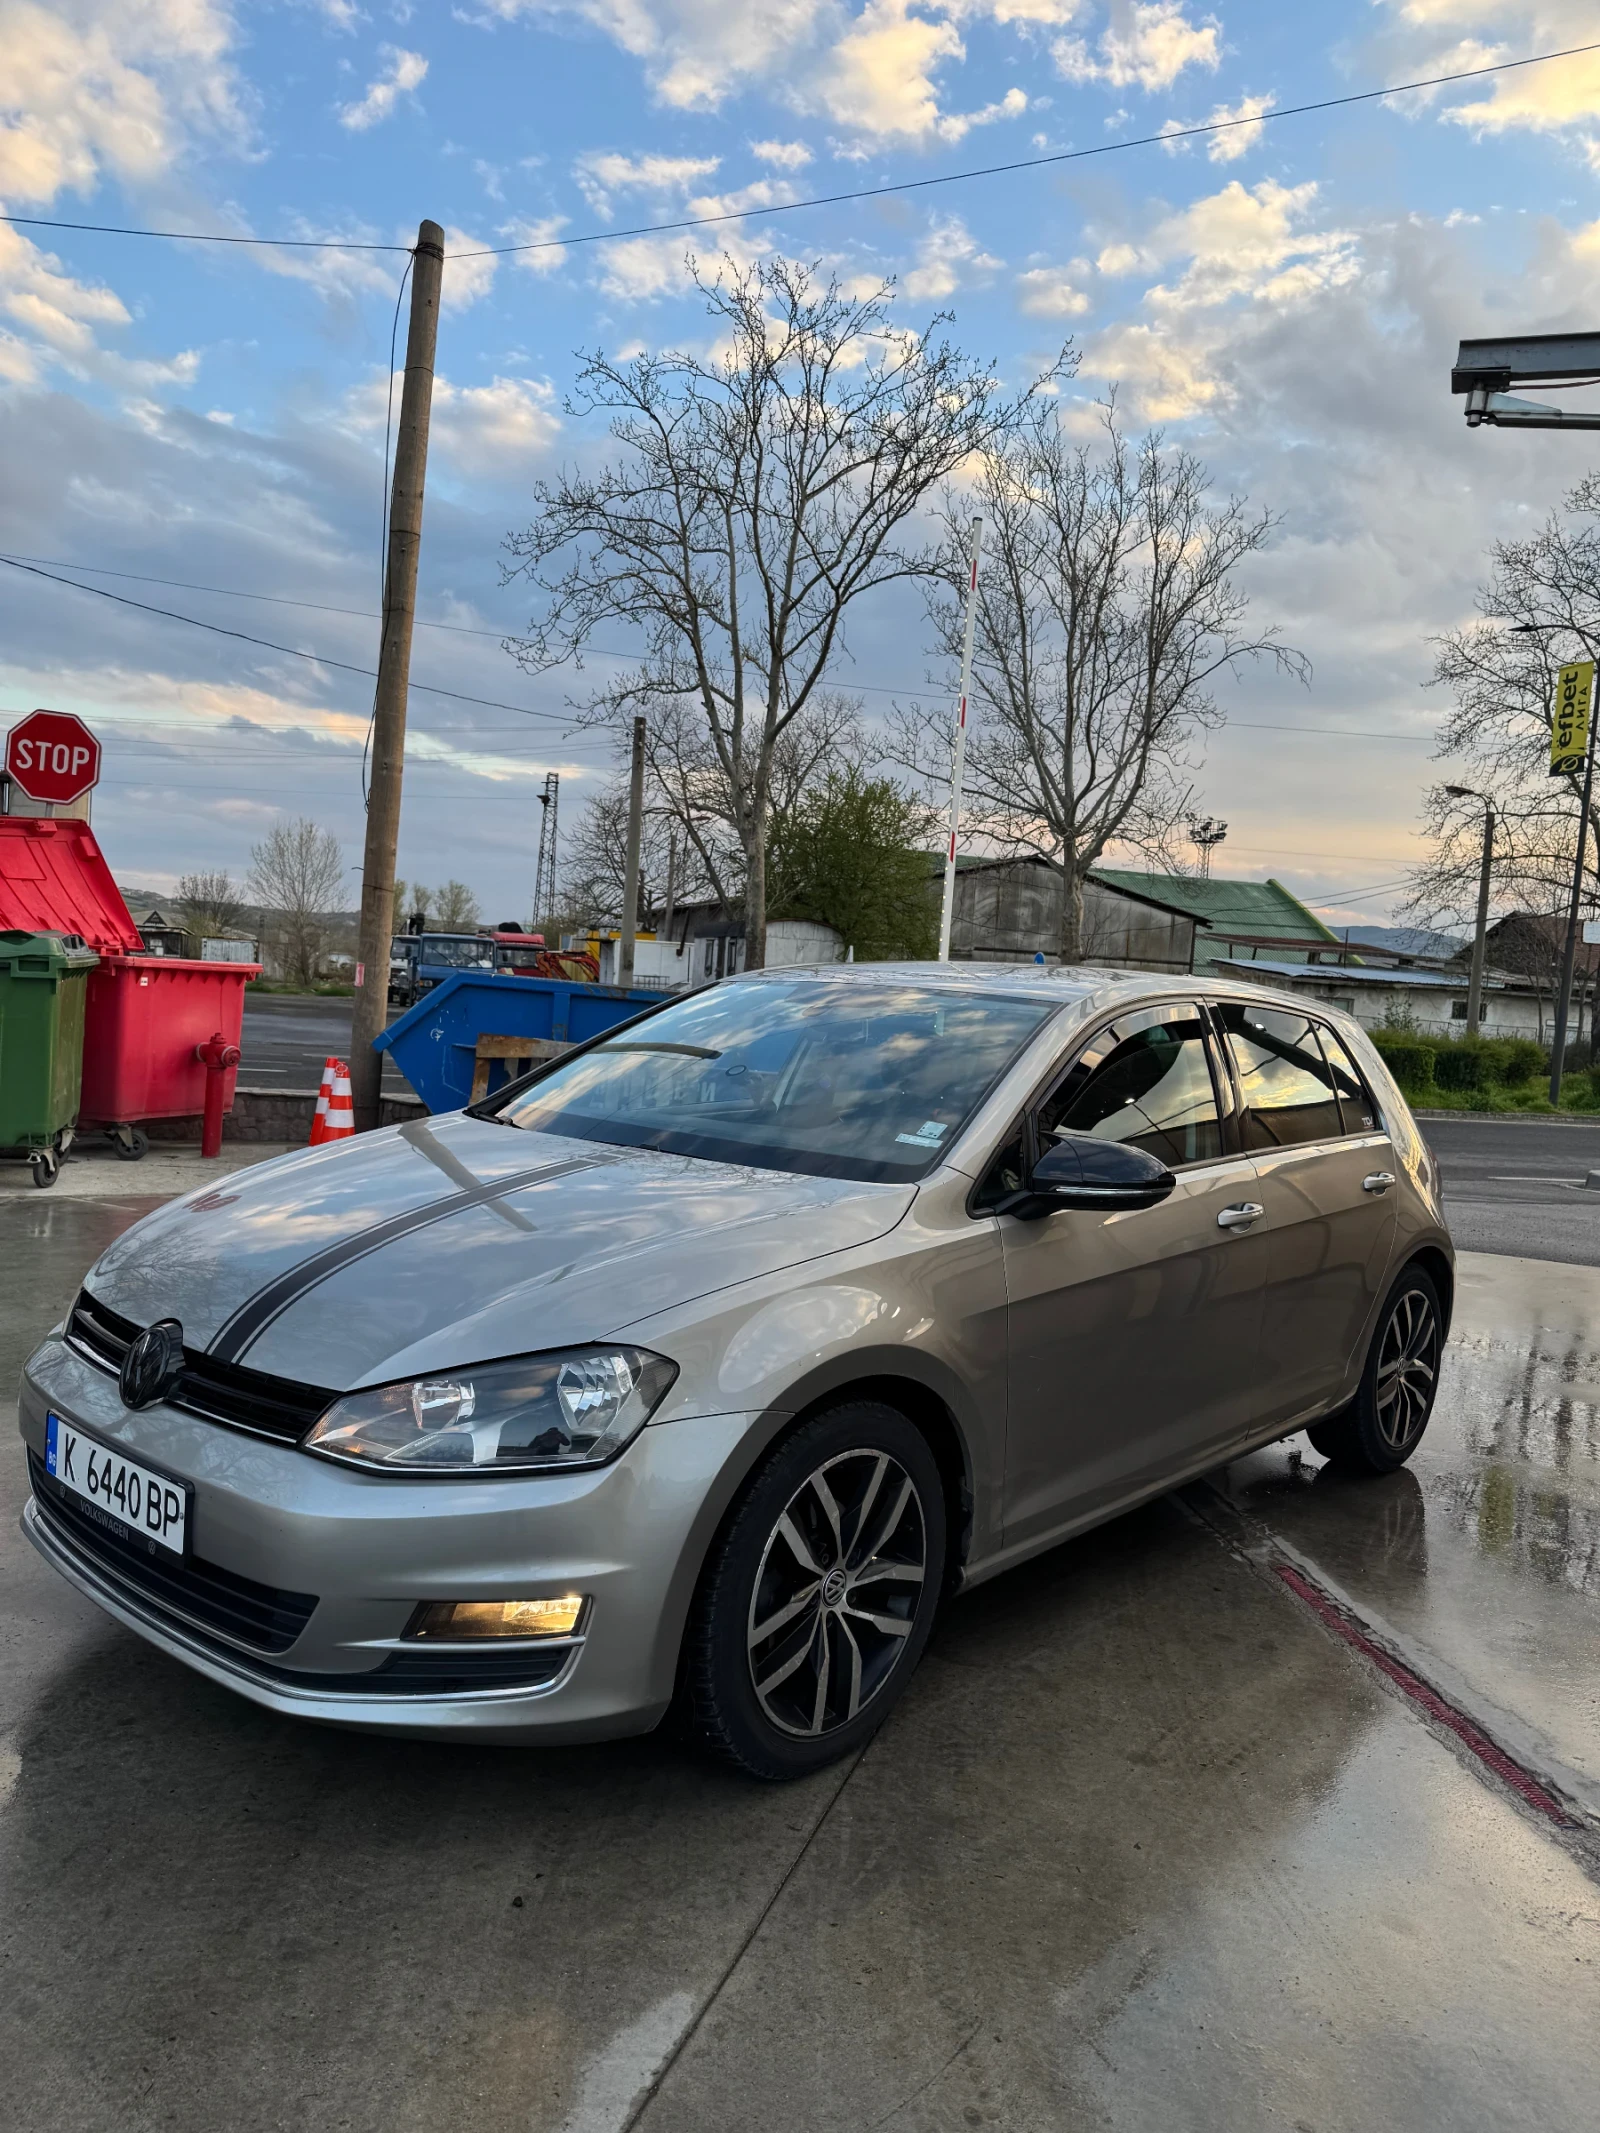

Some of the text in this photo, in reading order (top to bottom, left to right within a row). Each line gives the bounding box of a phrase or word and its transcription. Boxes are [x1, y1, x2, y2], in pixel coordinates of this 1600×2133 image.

[1557, 671, 1578, 750] efbet
[1575, 686, 1588, 731] ЛИГА
[16, 738, 90, 776] STOP
[48, 1450, 57, 1467] BG
[64, 1432, 180, 1537] K 6440 BP
[80, 1499, 129, 1541] VOLKSWAGEN
